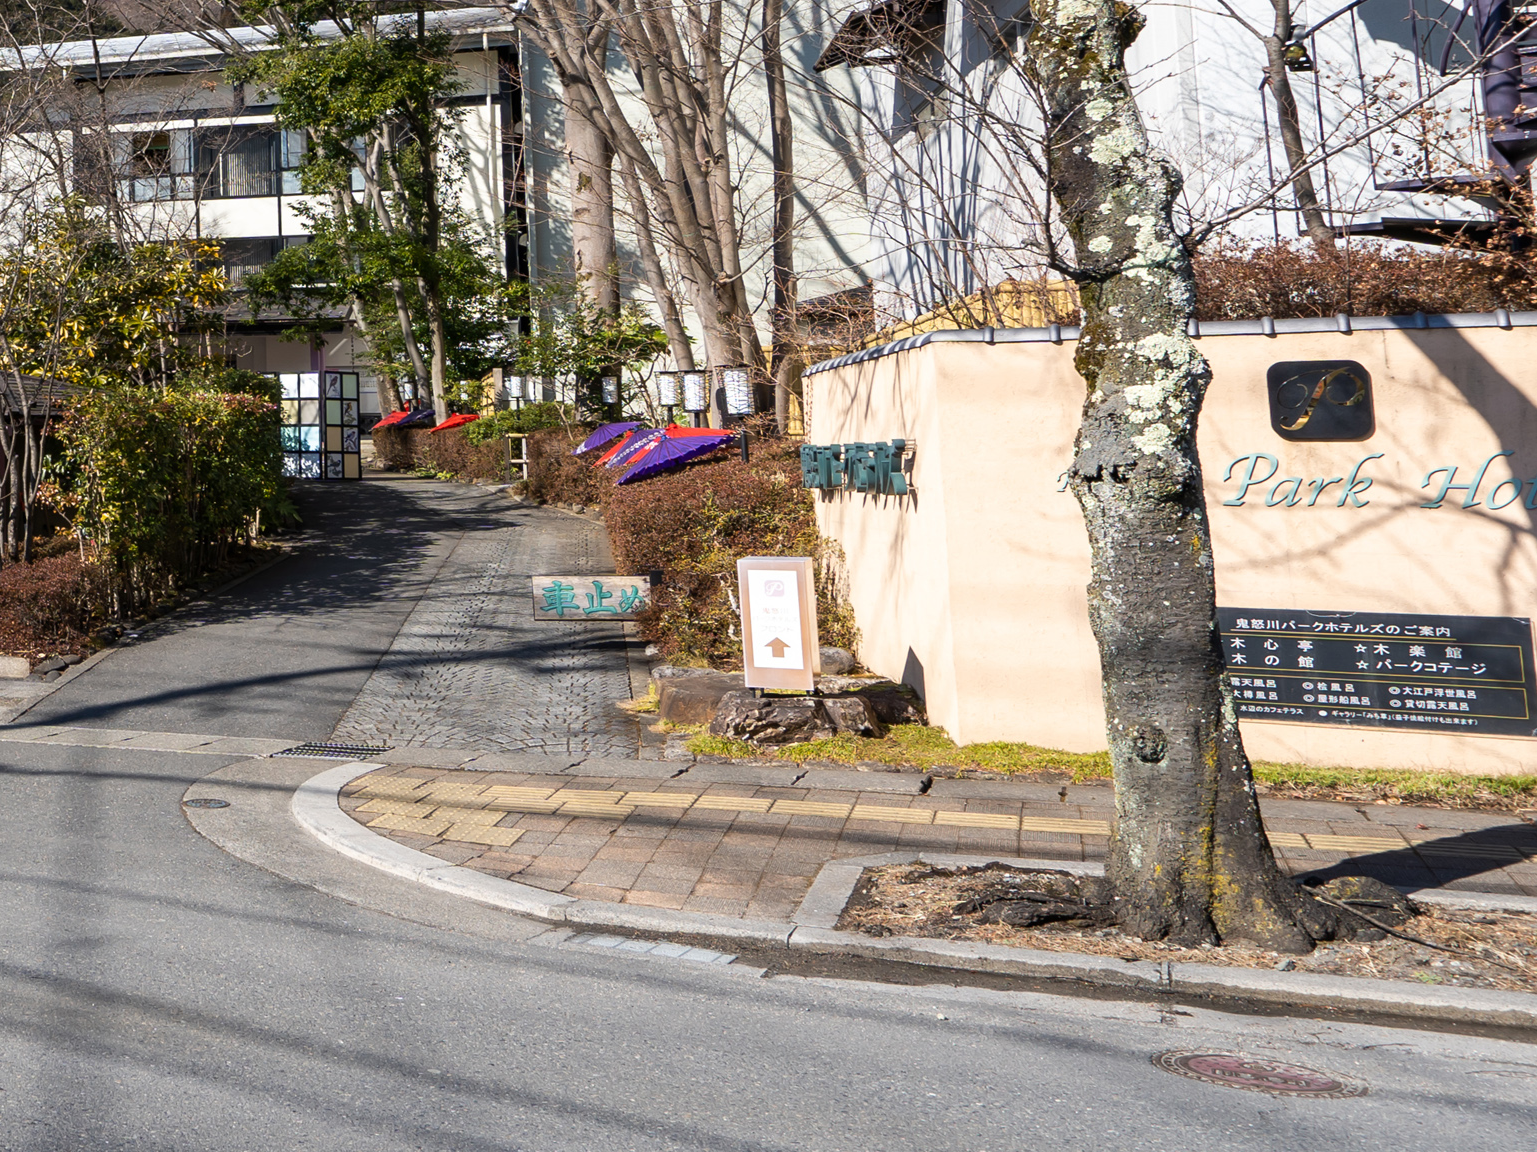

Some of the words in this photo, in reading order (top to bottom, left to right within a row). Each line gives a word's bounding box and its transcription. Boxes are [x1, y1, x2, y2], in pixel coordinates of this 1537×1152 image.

[1222, 452, 1385, 509] Park
[539, 579, 645, 617] 車止め
[1376, 659, 1487, 676] パークコテージ
[1402, 686, 1477, 700] 大江戸浮世風呂
[1317, 694, 1371, 706] 屋形船風呂
[1404, 699, 1470, 711] 貸切露天風呂
